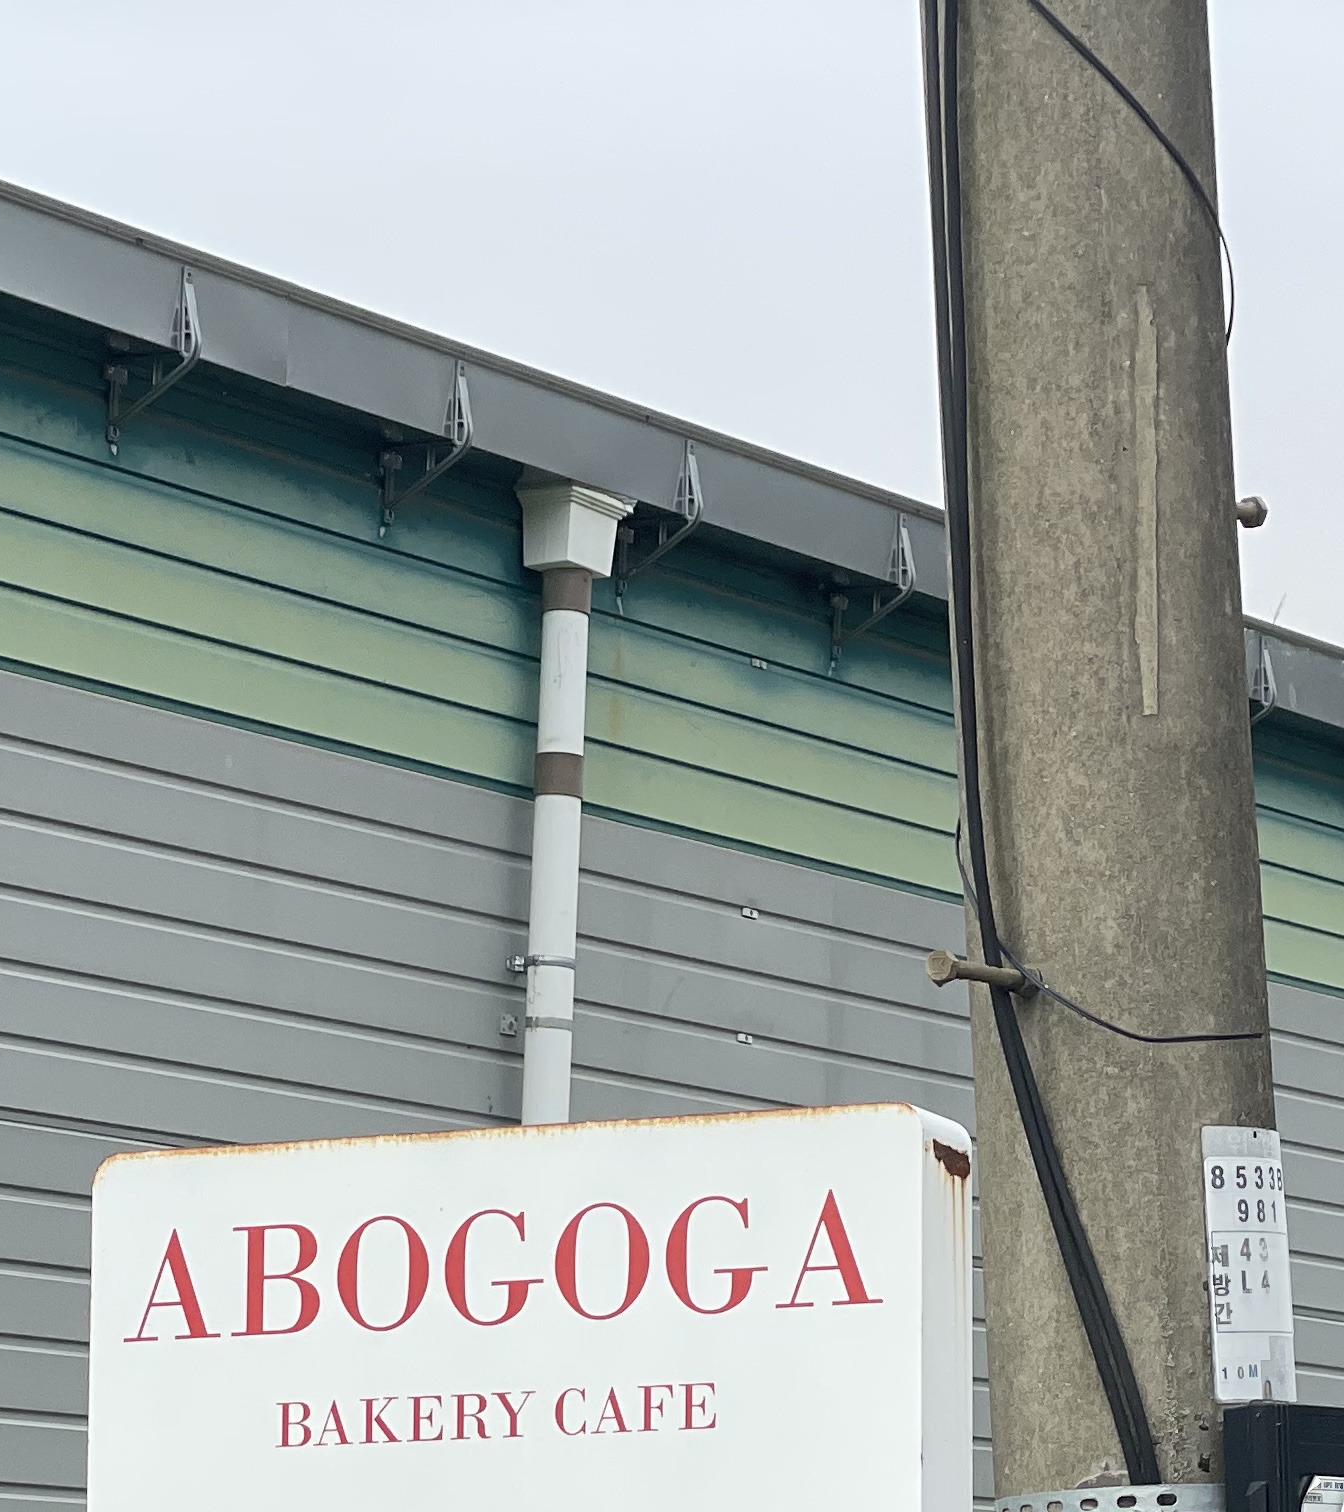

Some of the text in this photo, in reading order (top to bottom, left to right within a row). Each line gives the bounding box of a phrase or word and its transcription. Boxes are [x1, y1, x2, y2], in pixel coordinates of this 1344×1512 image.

[1237, 1198, 1278, 1224] 981
[122, 1188, 884, 1343] ABOGOGA
[275, 1382, 719, 1449] BAKERY CAFE
